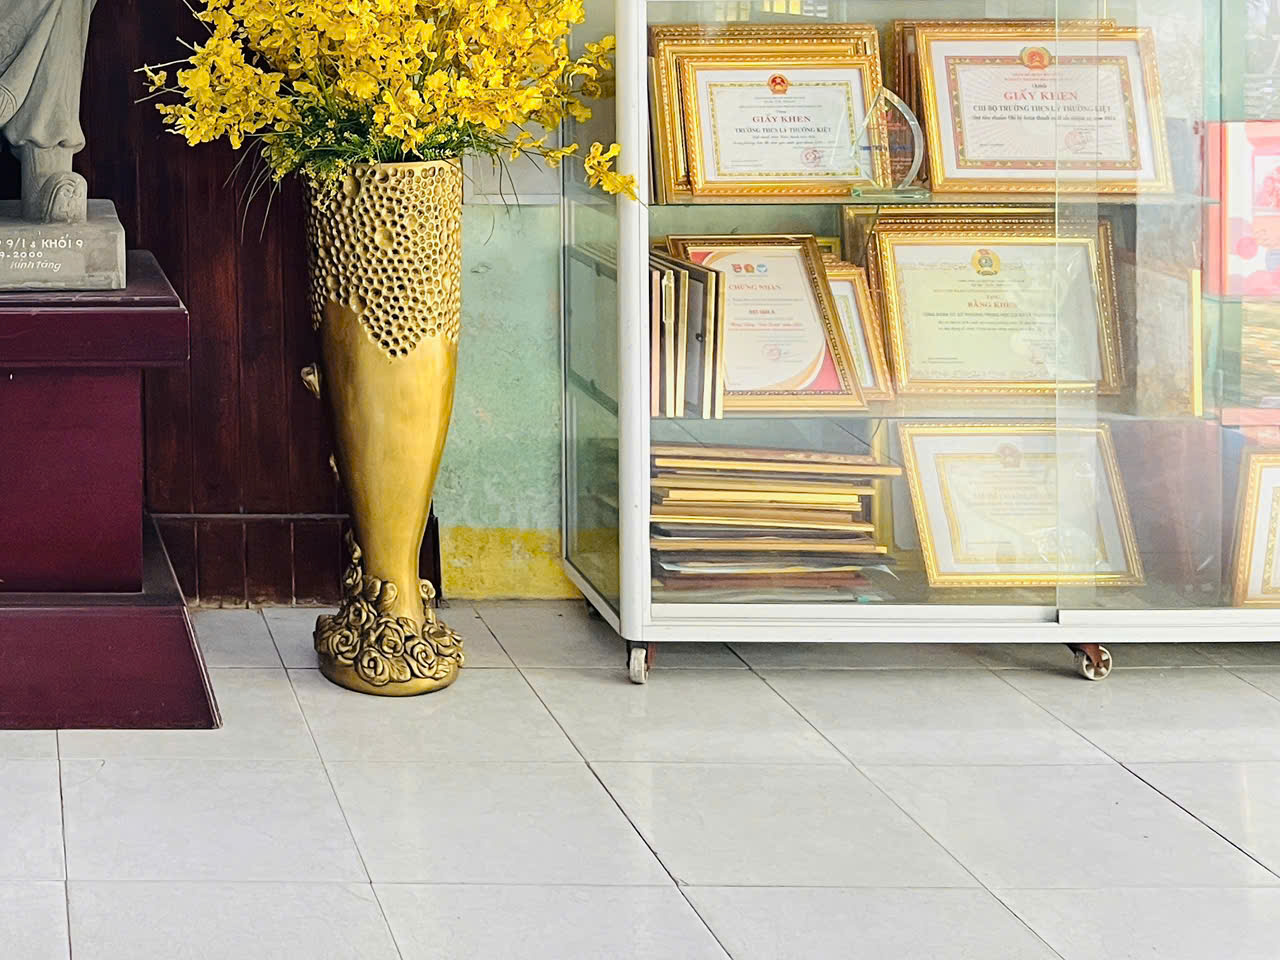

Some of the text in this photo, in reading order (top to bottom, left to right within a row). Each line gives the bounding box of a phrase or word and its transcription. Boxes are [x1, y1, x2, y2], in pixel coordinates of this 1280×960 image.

[1004, 88, 1078, 101] GIẤY KHEN
[752, 113, 811, 123] GIẤY KHEN
[41, 233, 71, 249] KHỐI
[75, 239, 84, 249] 9
